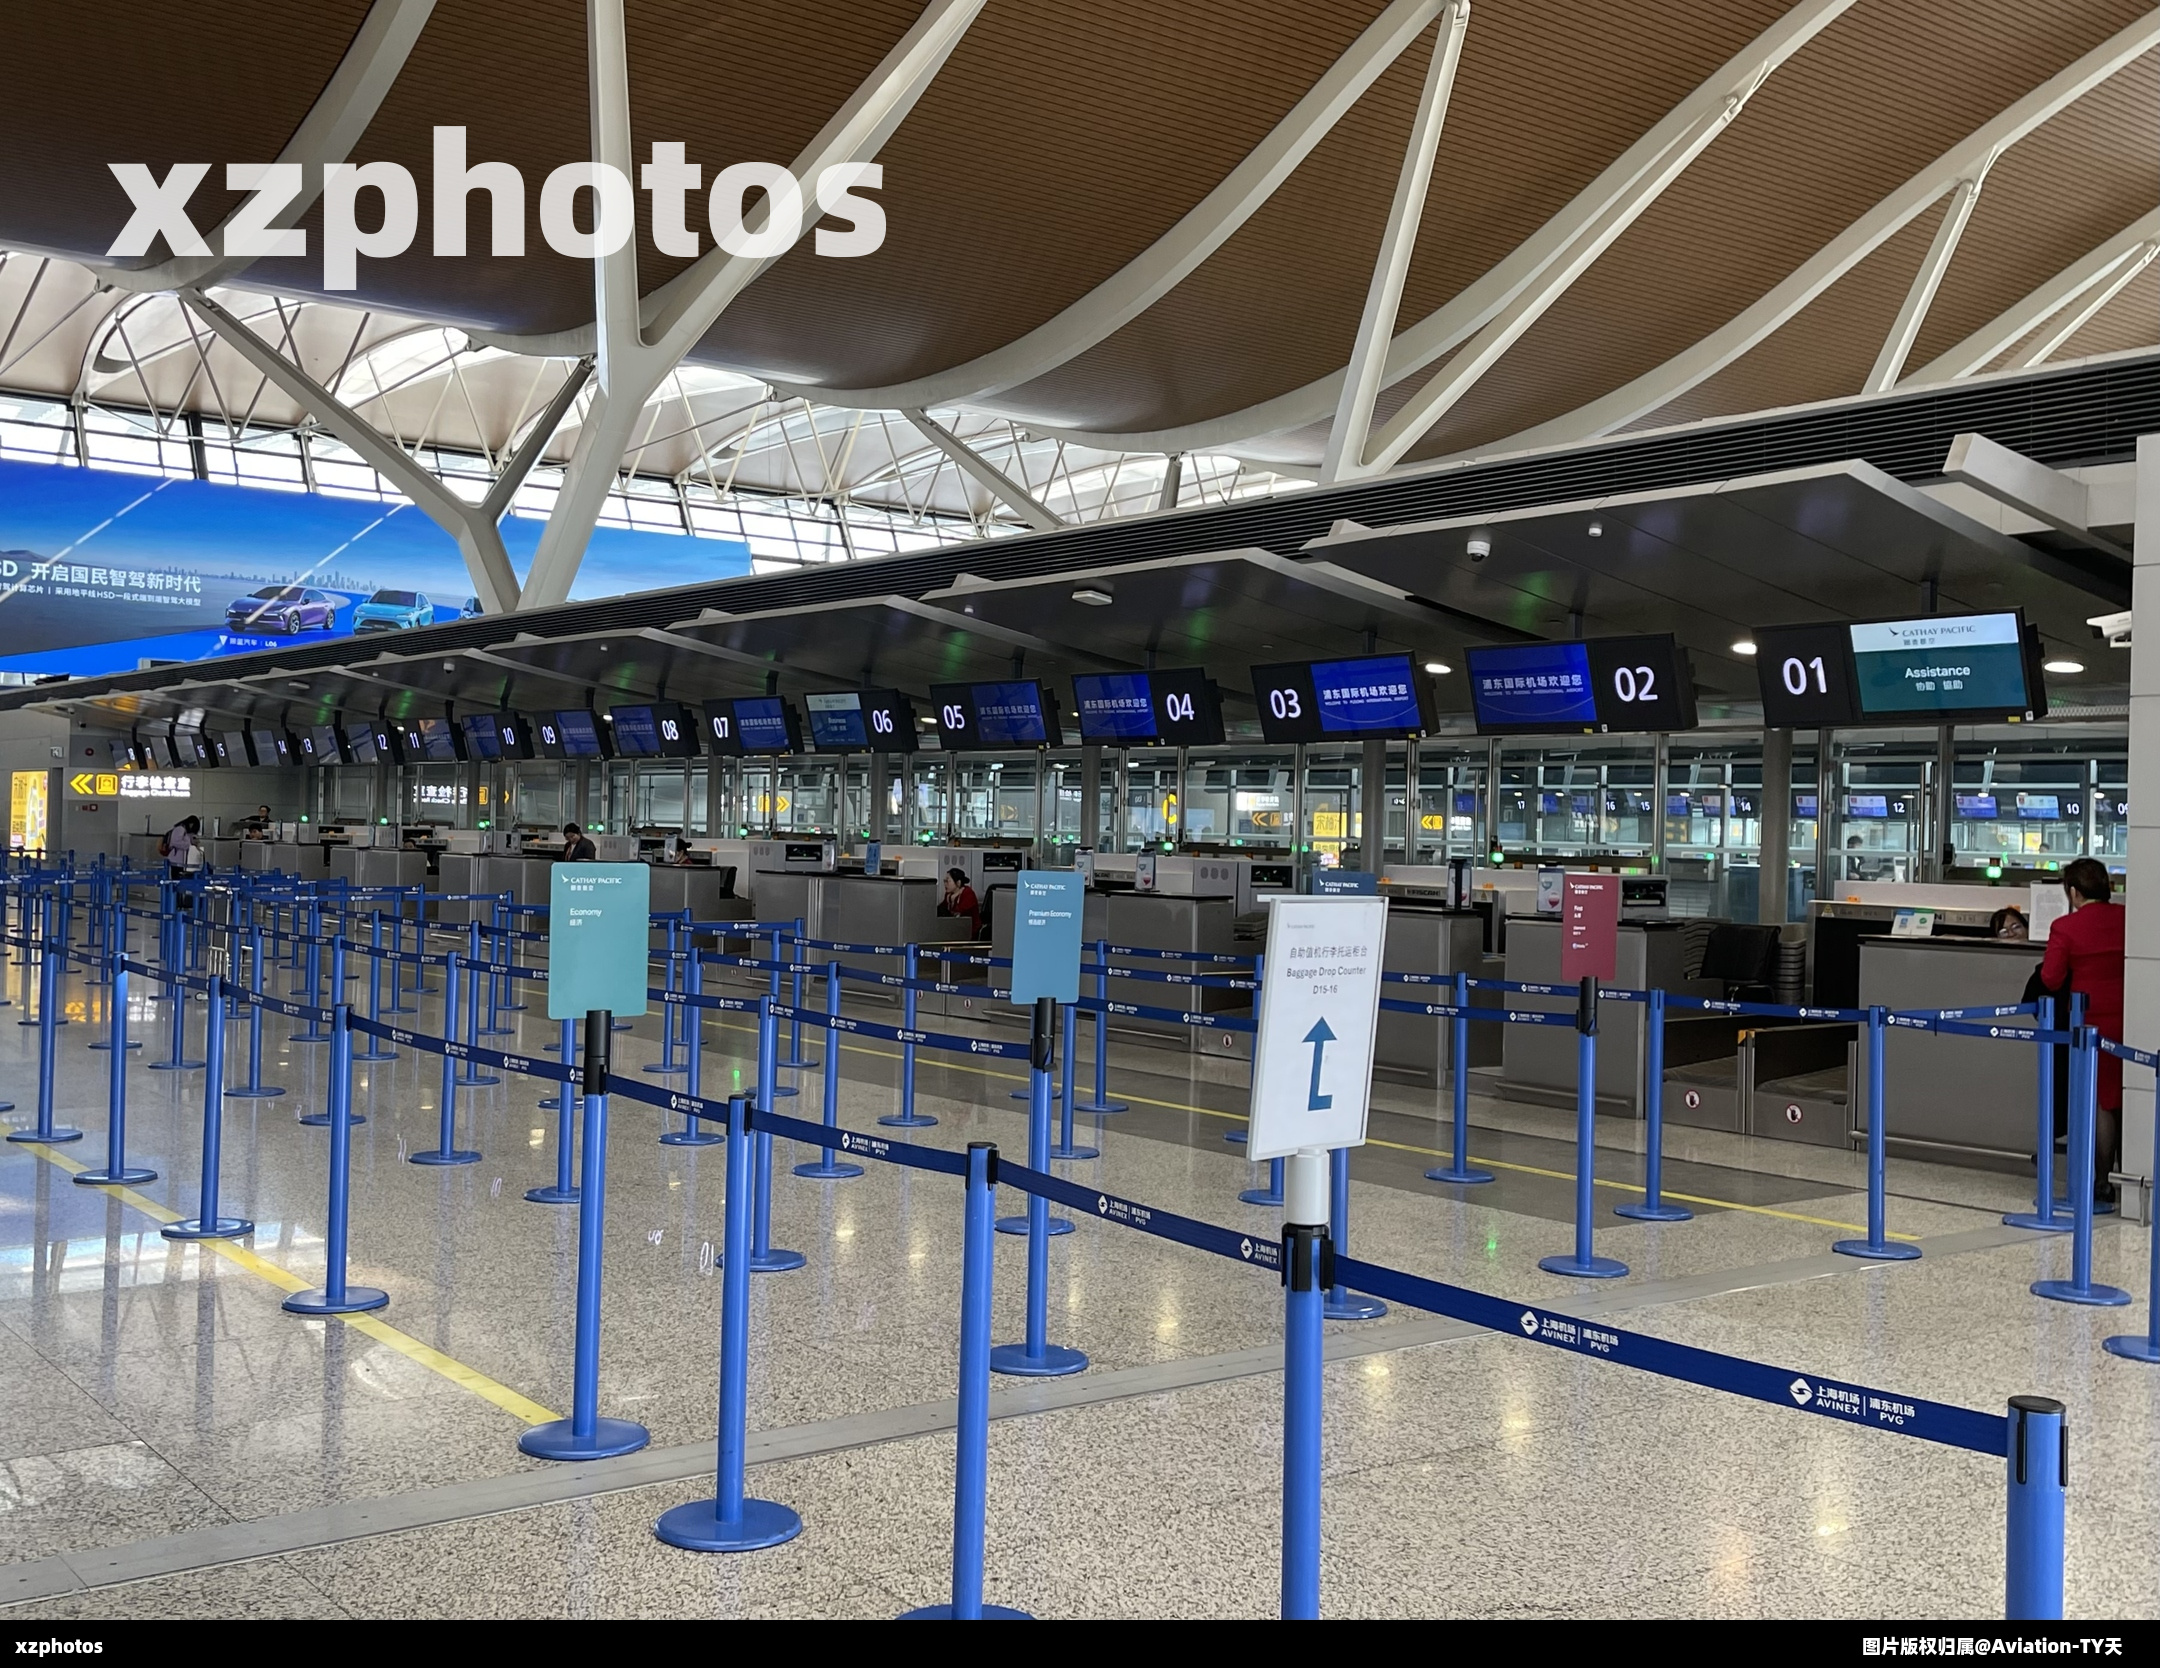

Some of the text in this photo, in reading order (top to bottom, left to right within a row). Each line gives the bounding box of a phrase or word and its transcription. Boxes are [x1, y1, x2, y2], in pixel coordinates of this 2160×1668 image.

[0, 560, 202, 593] D 开启国民智驾新时代
[1902, 625, 1976, 637] CATHAY PACIFIC
[1783, 656, 1828, 696] 01
[1905, 666, 1971, 678] Assistance
[1483, 674, 1583, 690] 浦东国际机场欢迎您
[1614, 666, 1658, 702] 02
[1323, 684, 1408, 700] 浦东国际机场欢迎您
[1166, 693, 1194, 721] 04
[1270, 689, 1301, 719] 03
[872, 709, 893, 733] 06
[943, 705, 965, 729] 05
[542, 726, 556, 744] 09
[662, 720, 679, 740] 08
[713, 717, 729, 738] 07
[378, 734, 388, 750] 12
[410, 732, 420, 748] 11
[503, 727, 514, 745] 10
[278, 740, 287, 754] 14
[1517, 800, 1525, 810] 17
[1606, 801, 1616, 811] 16
[1641, 801, 1651, 811] 15
[1893, 802, 1905, 813] 12
[2066, 803, 2080, 815] 10
[570, 908, 602, 917] Economy
[1050, 910, 1072, 919] Economy
[1290, 946, 1368, 959] 自助值机行李托运柜台
[1286, 965, 1367, 979] Baggage Drop Counter
[1313, 984, 1338, 995] D15-16
[1541, 1317, 1576, 1335] 上海机场
[1541, 1328, 1610, 1353] AVINEX PVG
[1816, 1385, 1915, 1418] 上海机场 浦东机场
[1816, 1398, 1904, 1425] AVINEX PVG
